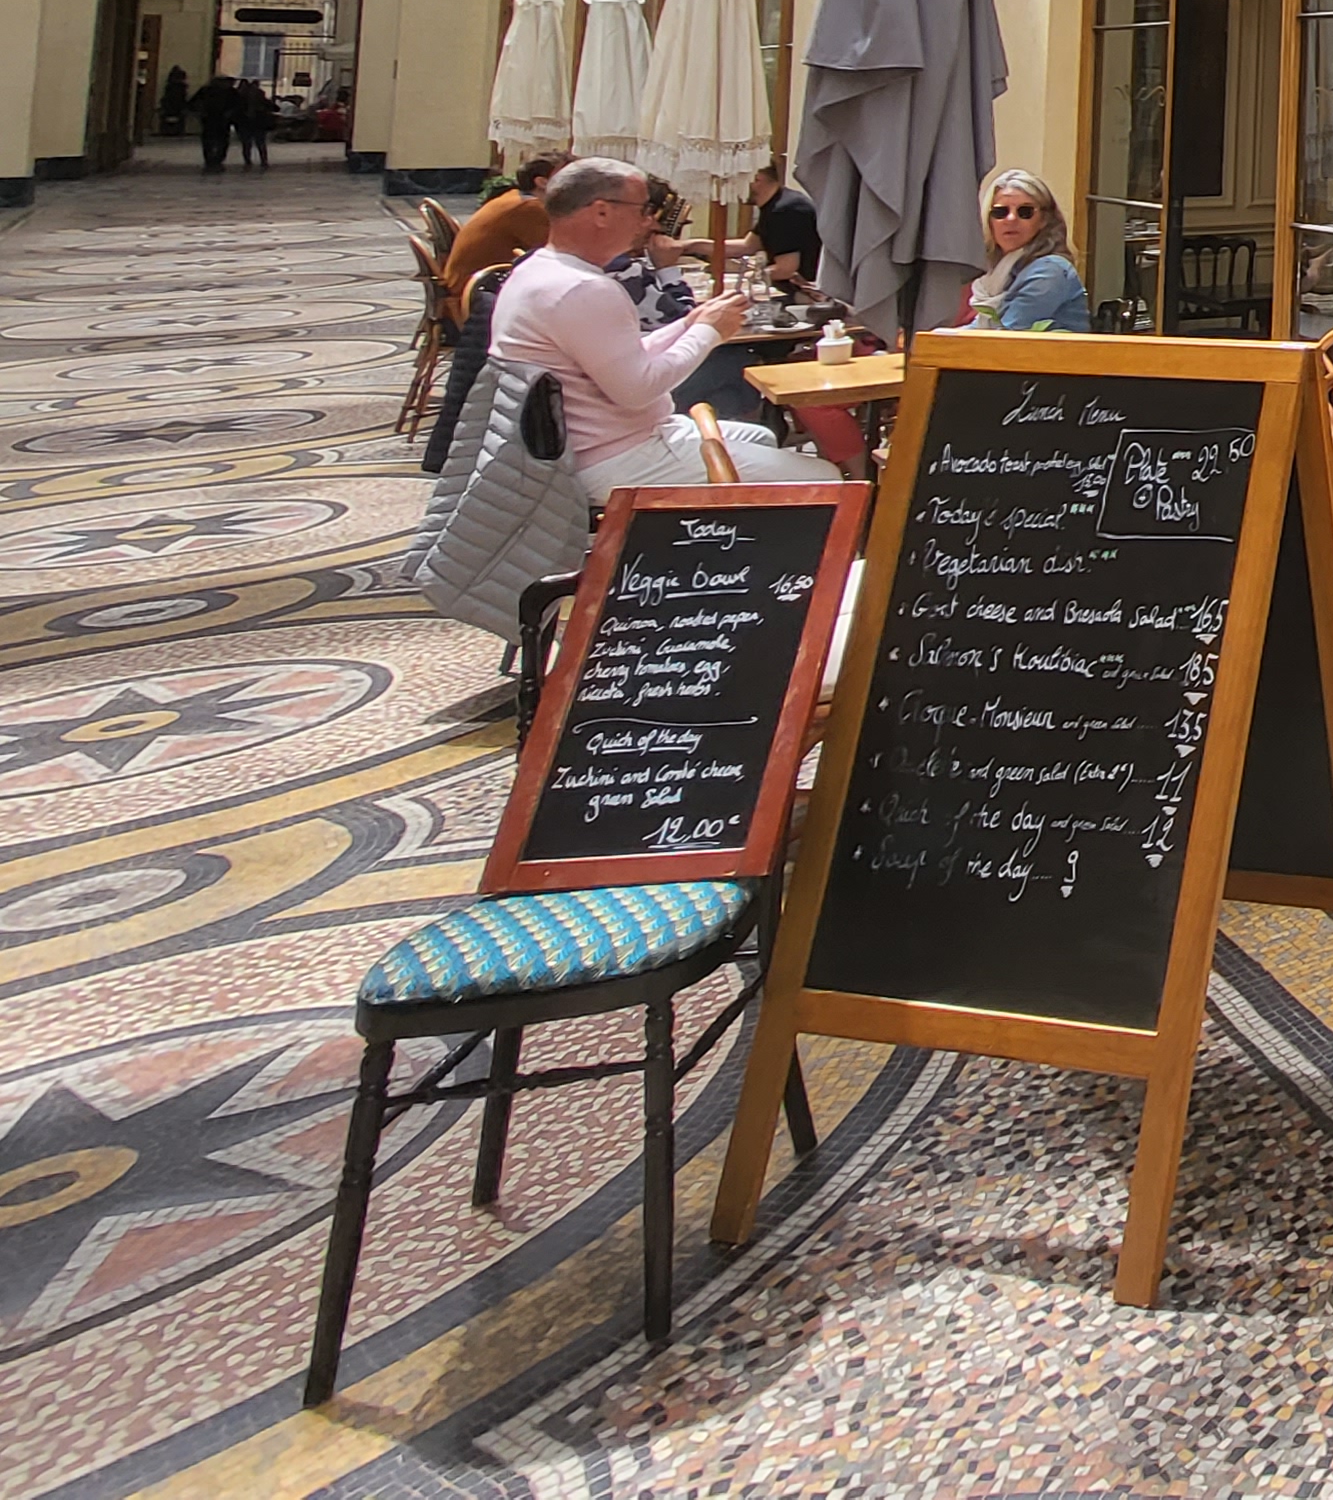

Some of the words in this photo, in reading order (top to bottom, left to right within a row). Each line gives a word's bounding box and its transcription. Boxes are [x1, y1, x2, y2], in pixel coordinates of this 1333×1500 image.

[1002, 381, 1066, 426] Lunch
[939, 443, 996, 474] Avocado
[679, 518, 737, 550] Today
[923, 538, 1034, 591] Vegetarian
[966, 595, 1018, 623] cheese
[1023, 599, 1058, 621] and
[619, 766, 651, 785] and
[1011, 800, 1046, 858] day
[998, 847, 1036, 902] day
